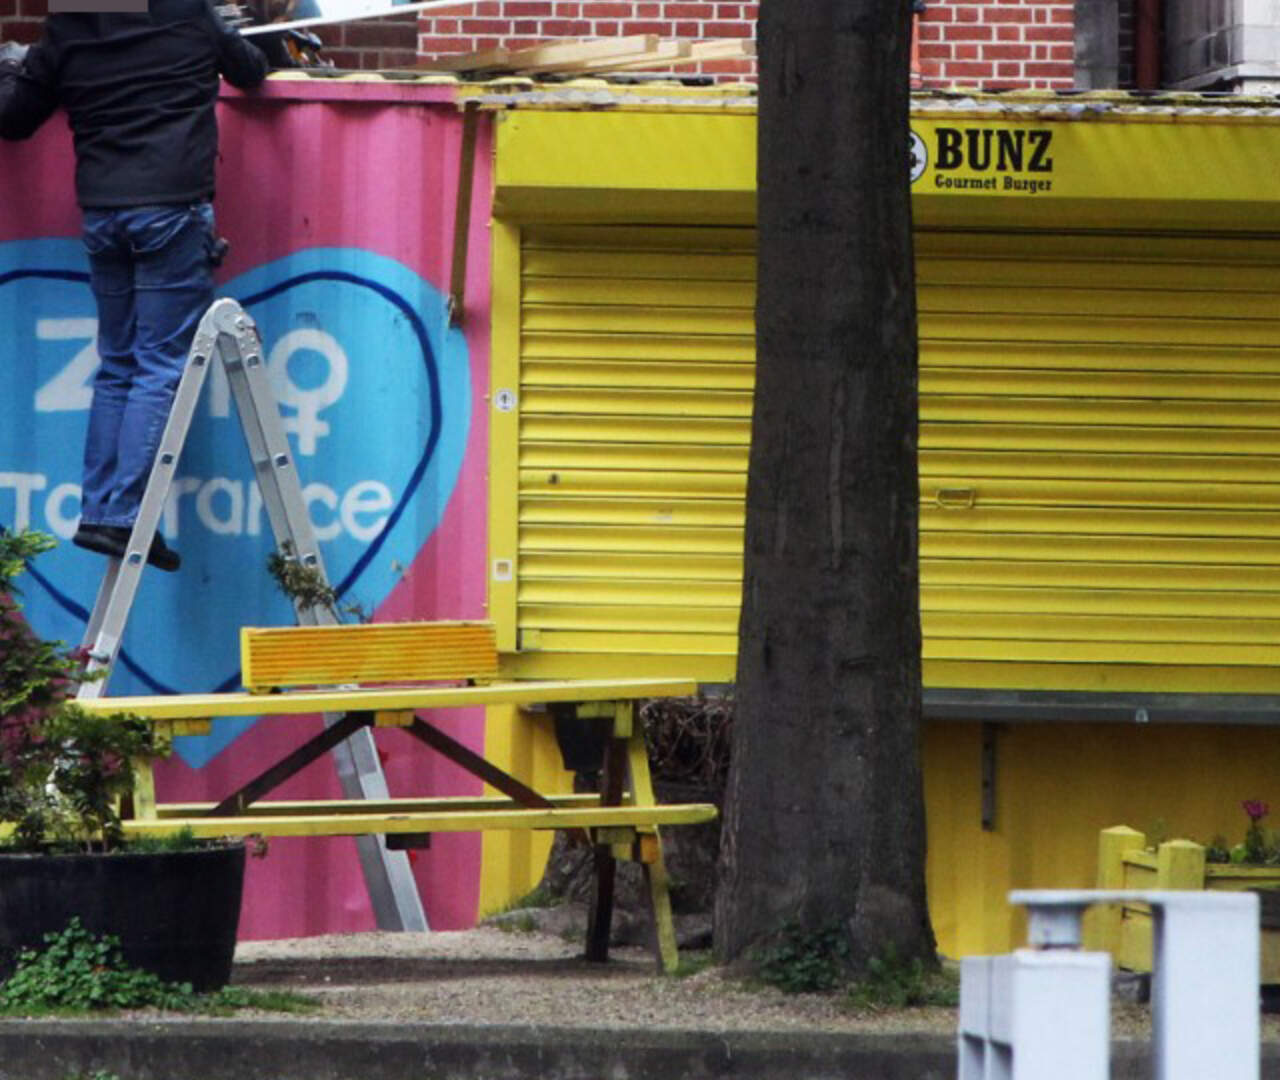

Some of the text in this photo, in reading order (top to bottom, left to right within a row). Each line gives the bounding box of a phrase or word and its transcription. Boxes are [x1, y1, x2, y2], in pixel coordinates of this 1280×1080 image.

[934, 127, 1053, 172] BUNZ
[934, 173, 1053, 194] Gourmet Burger
